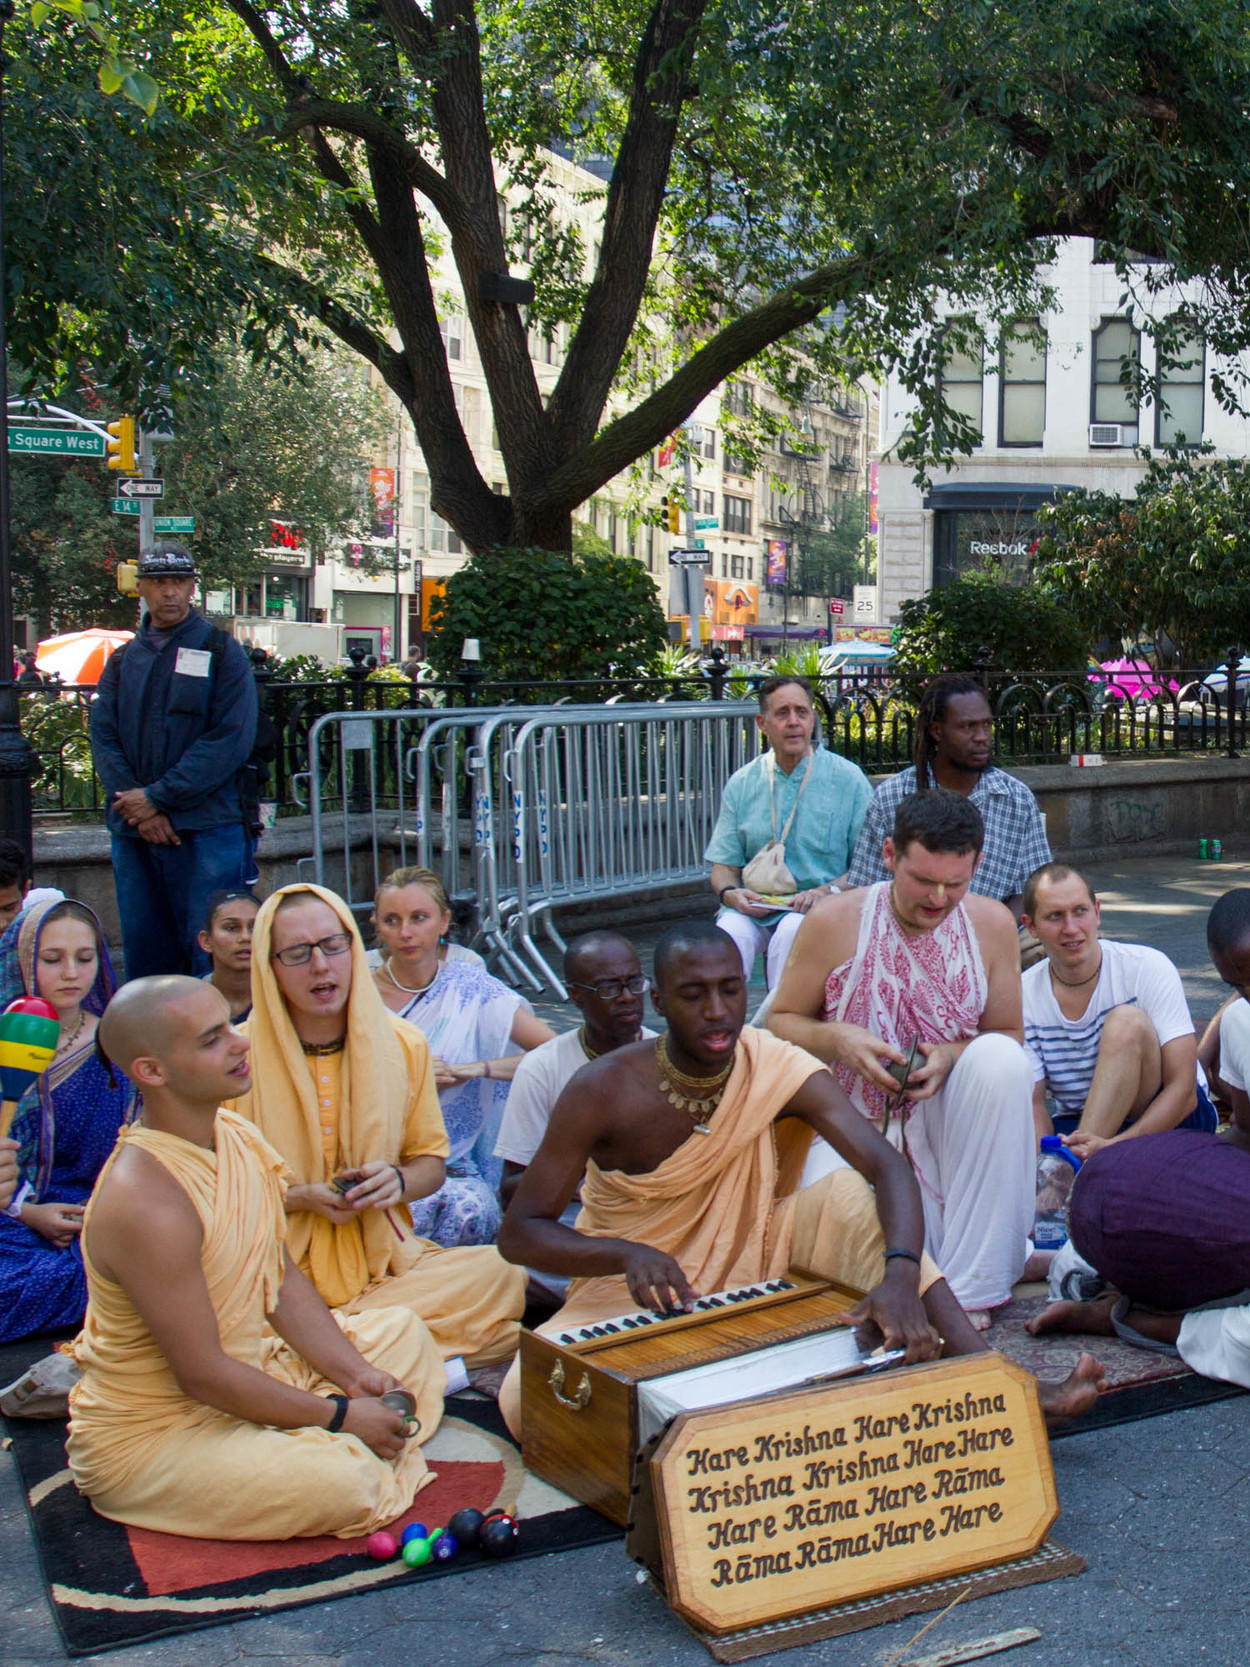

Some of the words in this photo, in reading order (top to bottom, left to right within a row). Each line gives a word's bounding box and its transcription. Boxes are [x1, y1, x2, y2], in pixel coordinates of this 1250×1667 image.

[15, 433, 62, 448] Square
[66, 436, 99, 450] West
[114, 501, 120, 511] E
[122, 502, 131, 512] 14
[126, 485, 139, 493] ONE
[145, 484, 159, 493] WAY
[970, 541, 1027, 555] Reebok
[856, 601, 873, 611] 25
[513, 794, 522, 860] NYPD
[686, 1446, 750, 1476] Hare
[753, 1425, 848, 1463] Krishna
[853, 1413, 910, 1443] Hare
[911, 1392, 1006, 1431] Krishna
[687, 1474, 795, 1513] Krishna
[802, 1451, 900, 1490] Krishna
[903, 1438, 956, 1469] Hare
[957, 1427, 1014, 1457] Hare
[707, 1515, 777, 1550] Hare
[783, 1499, 859, 1532] Rāma
[865, 1482, 927, 1516] Hare
[931, 1467, 1005, 1499] Rāma
[710, 1553, 793, 1588] Rāma
[794, 1533, 872, 1570] Rāma
[872, 1518, 936, 1553] Hare
[940, 1502, 1003, 1537] Hare
